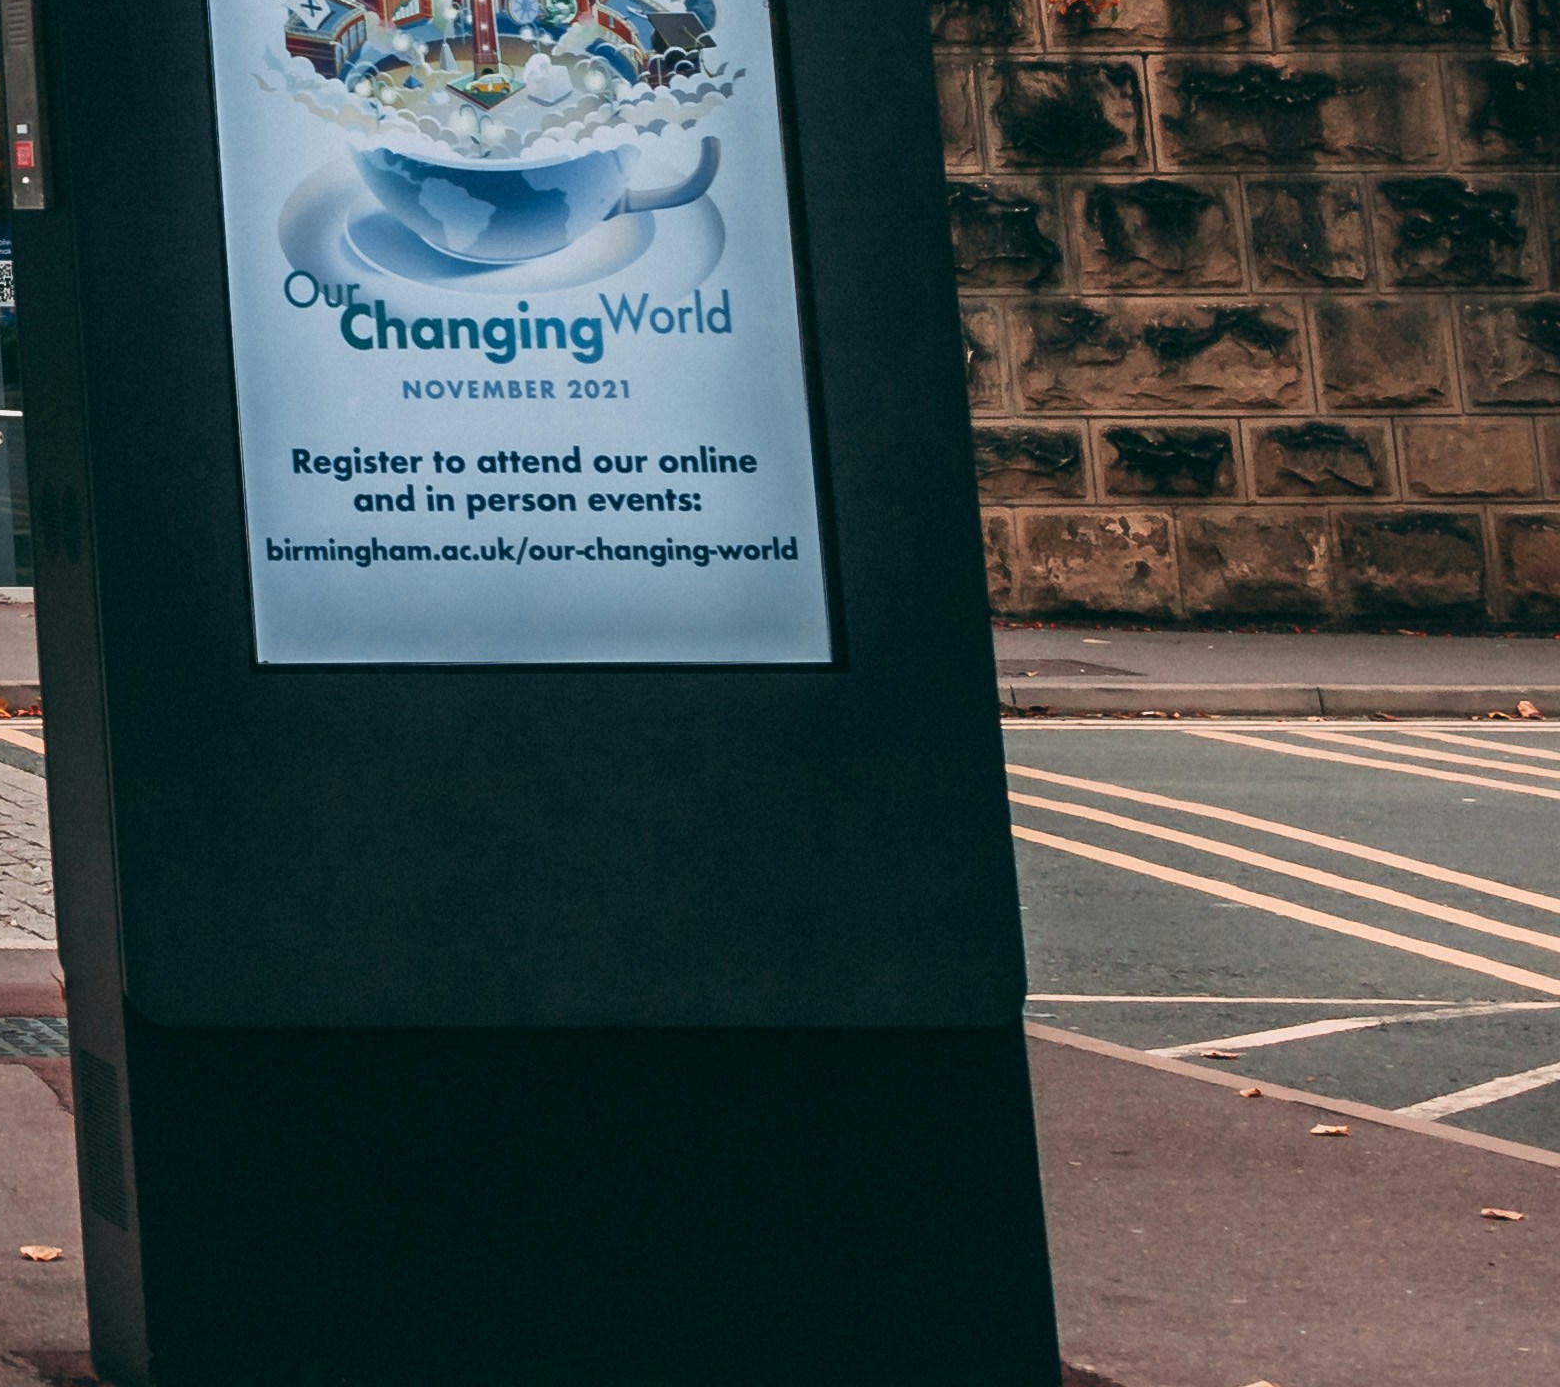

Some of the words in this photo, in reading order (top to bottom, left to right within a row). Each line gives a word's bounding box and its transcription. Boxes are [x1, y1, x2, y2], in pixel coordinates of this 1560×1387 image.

[283, 270, 360, 309] Our
[340, 299, 605, 365] Changing
[599, 289, 733, 336] World
[402, 380, 556, 400] NOVEMBER
[567, 379, 632, 400] 2021
[291, 447, 423, 482] Register
[433, 449, 466, 475] to
[477, 447, 582, 475] attend
[593, 452, 648, 475] our
[658, 445, 758, 474] online
[353, 485, 416, 514] and
[426, 485, 455, 513] in
[466, 491, 577, 520] person
[587, 490, 702, 513] events:
[265, 536, 799, 567] birmingham.ac.uk/our-changing-world
